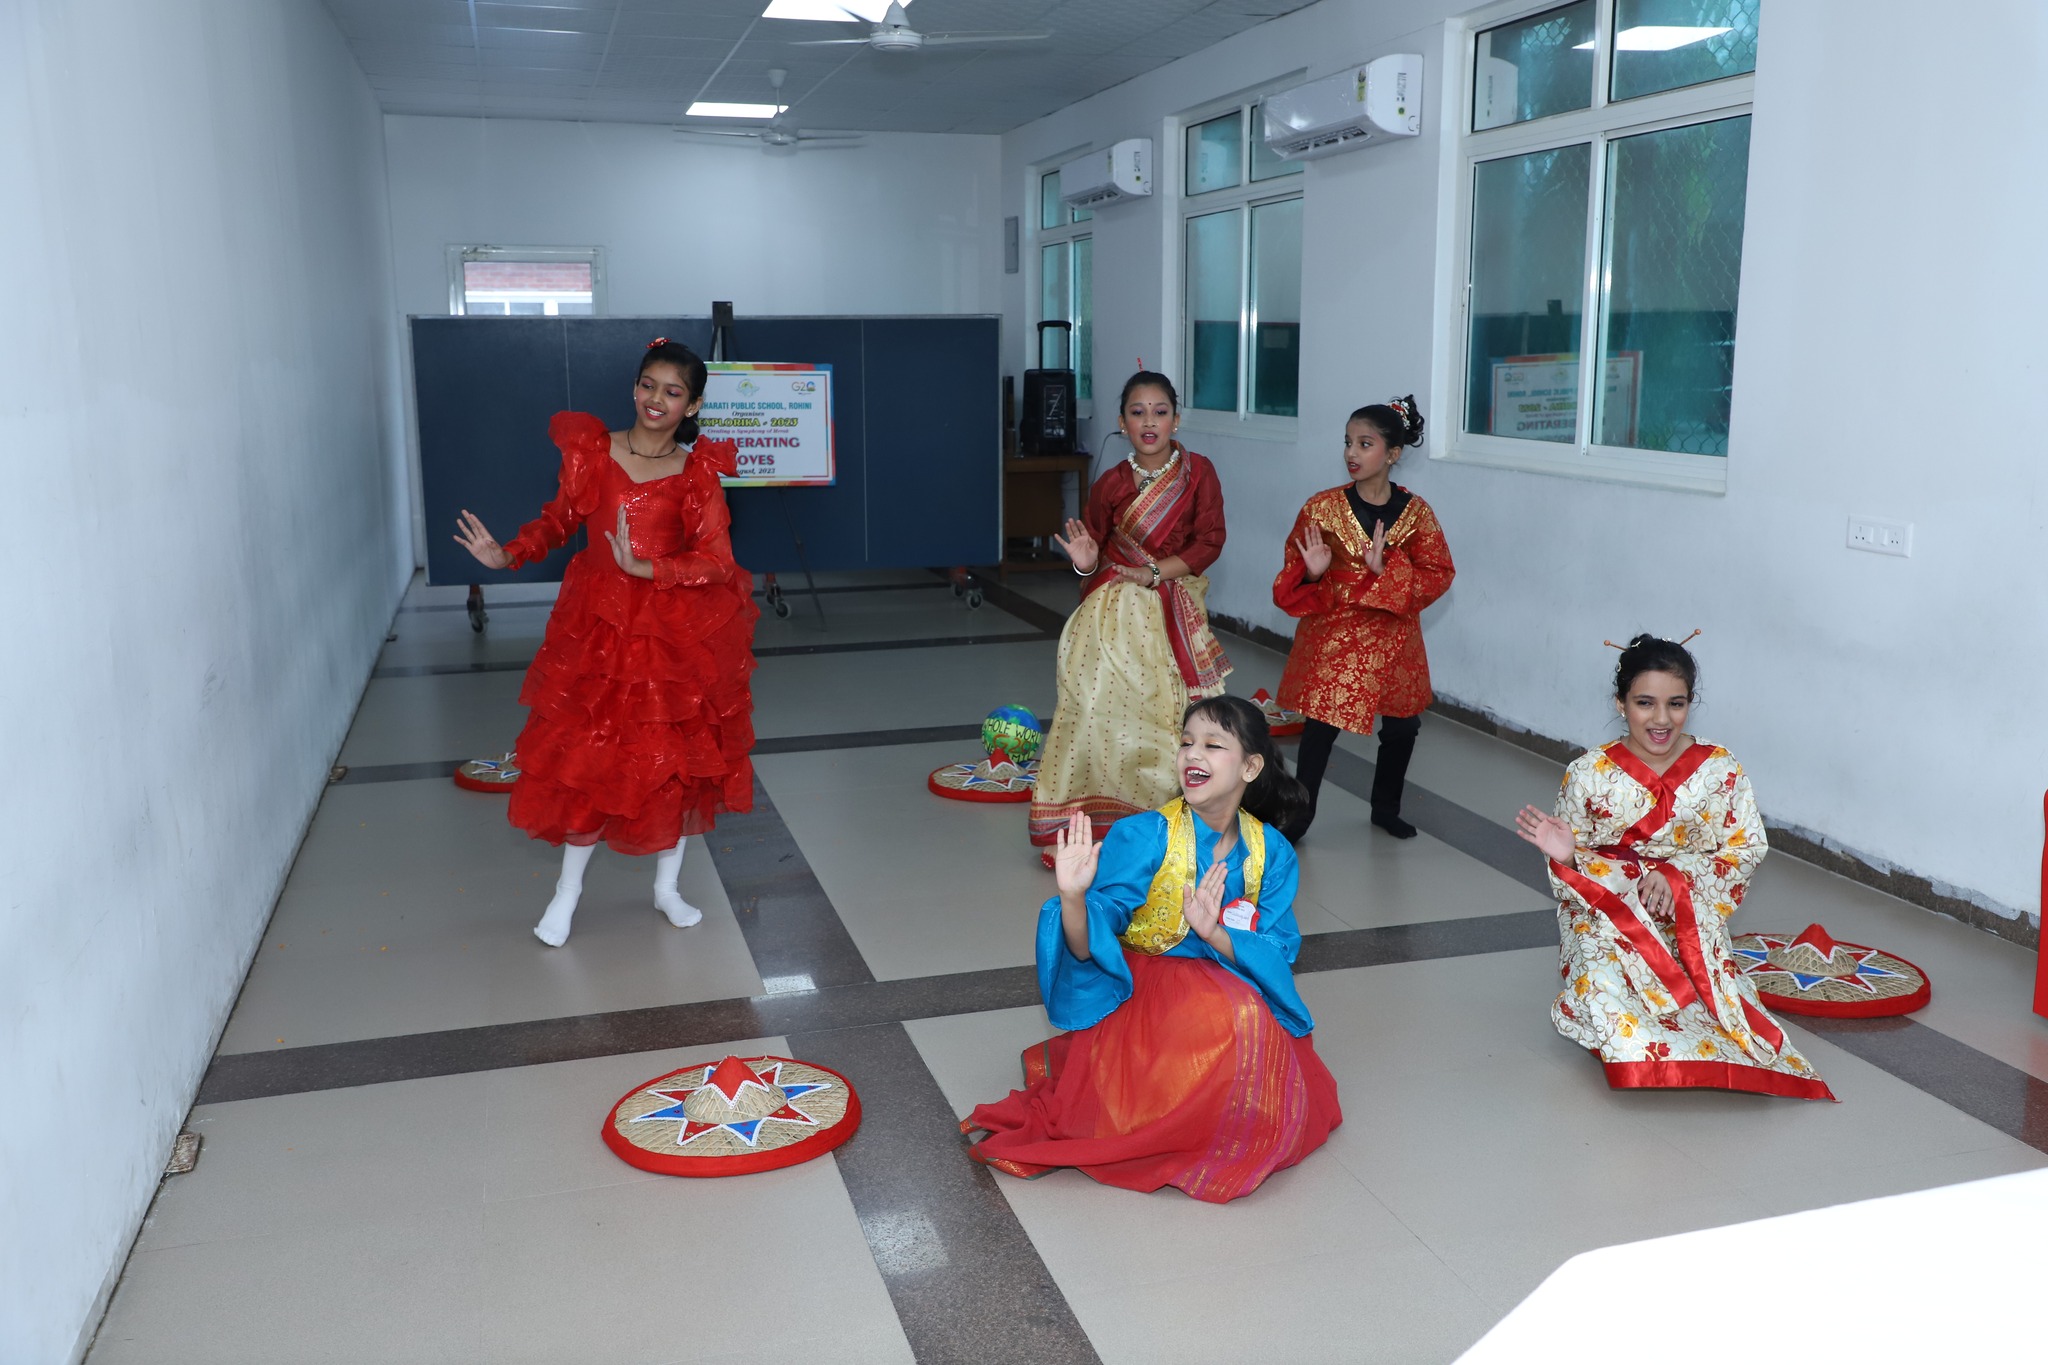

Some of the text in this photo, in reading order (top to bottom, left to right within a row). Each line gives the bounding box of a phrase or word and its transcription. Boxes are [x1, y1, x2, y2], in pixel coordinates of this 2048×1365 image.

[791, 381, 816, 392] G20
[731, 402, 756, 410] PUBLIC
[757, 402, 787, 411] SCHOOL,
[789, 402, 812, 410] ROHINI
[698, 417, 761, 427] EXPLORIKA
[770, 418, 799, 427] 2023
[737, 455, 775, 465] OVES
[736, 467, 756, 475] ugust,
[993, 733, 1031, 754] G20
